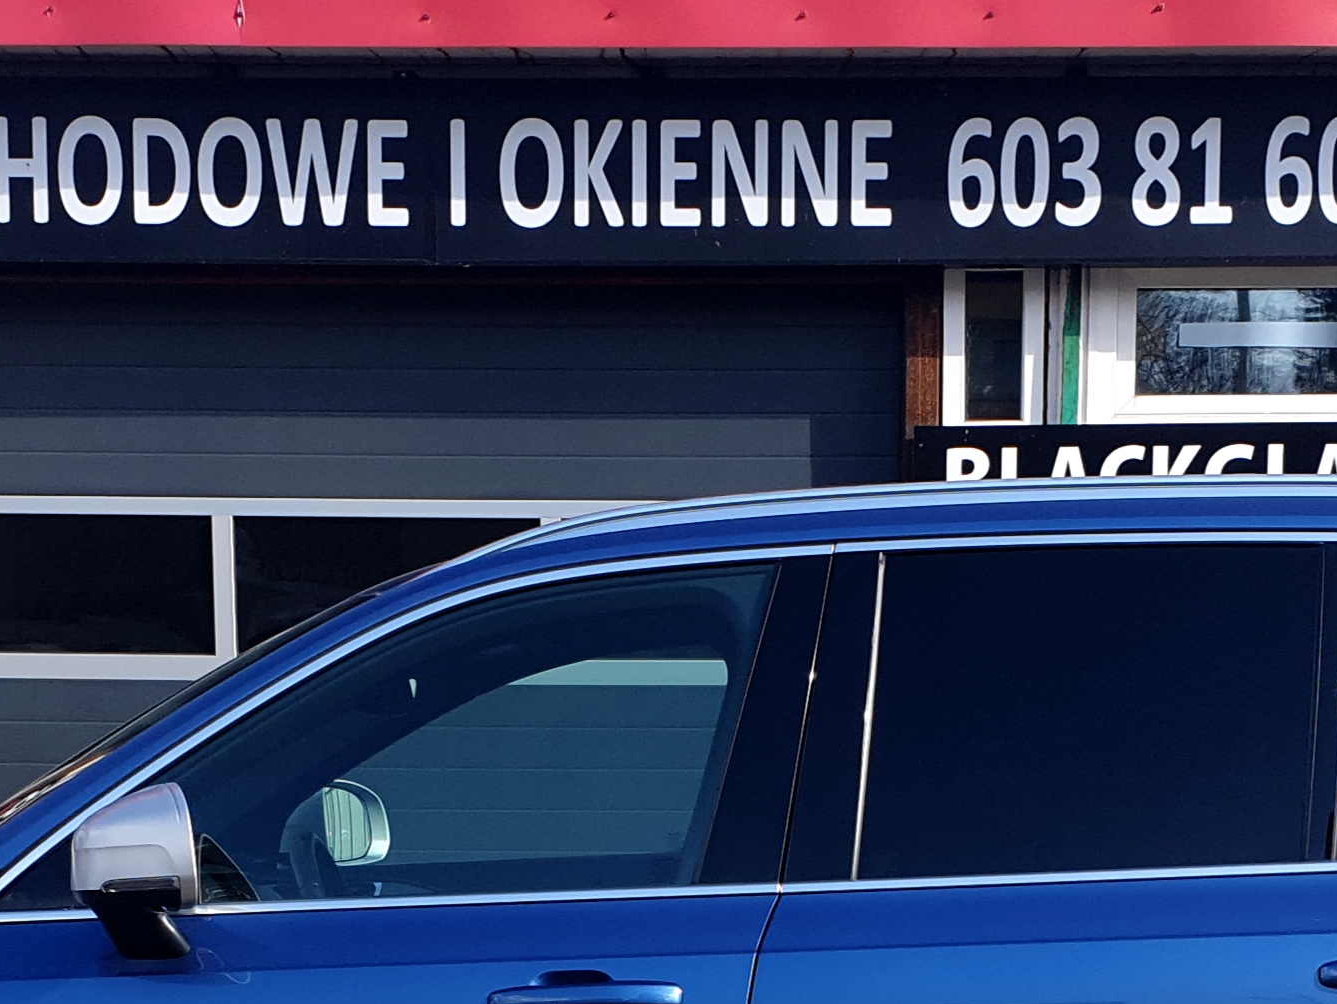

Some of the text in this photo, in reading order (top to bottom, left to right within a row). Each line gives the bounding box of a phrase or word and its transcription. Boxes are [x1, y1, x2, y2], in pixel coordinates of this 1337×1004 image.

[451, 119, 466, 226] I
[500, 118, 892, 228] OKIENNE
[948, 117, 1101, 227] 603
[1132, 117, 1233, 226] 81
